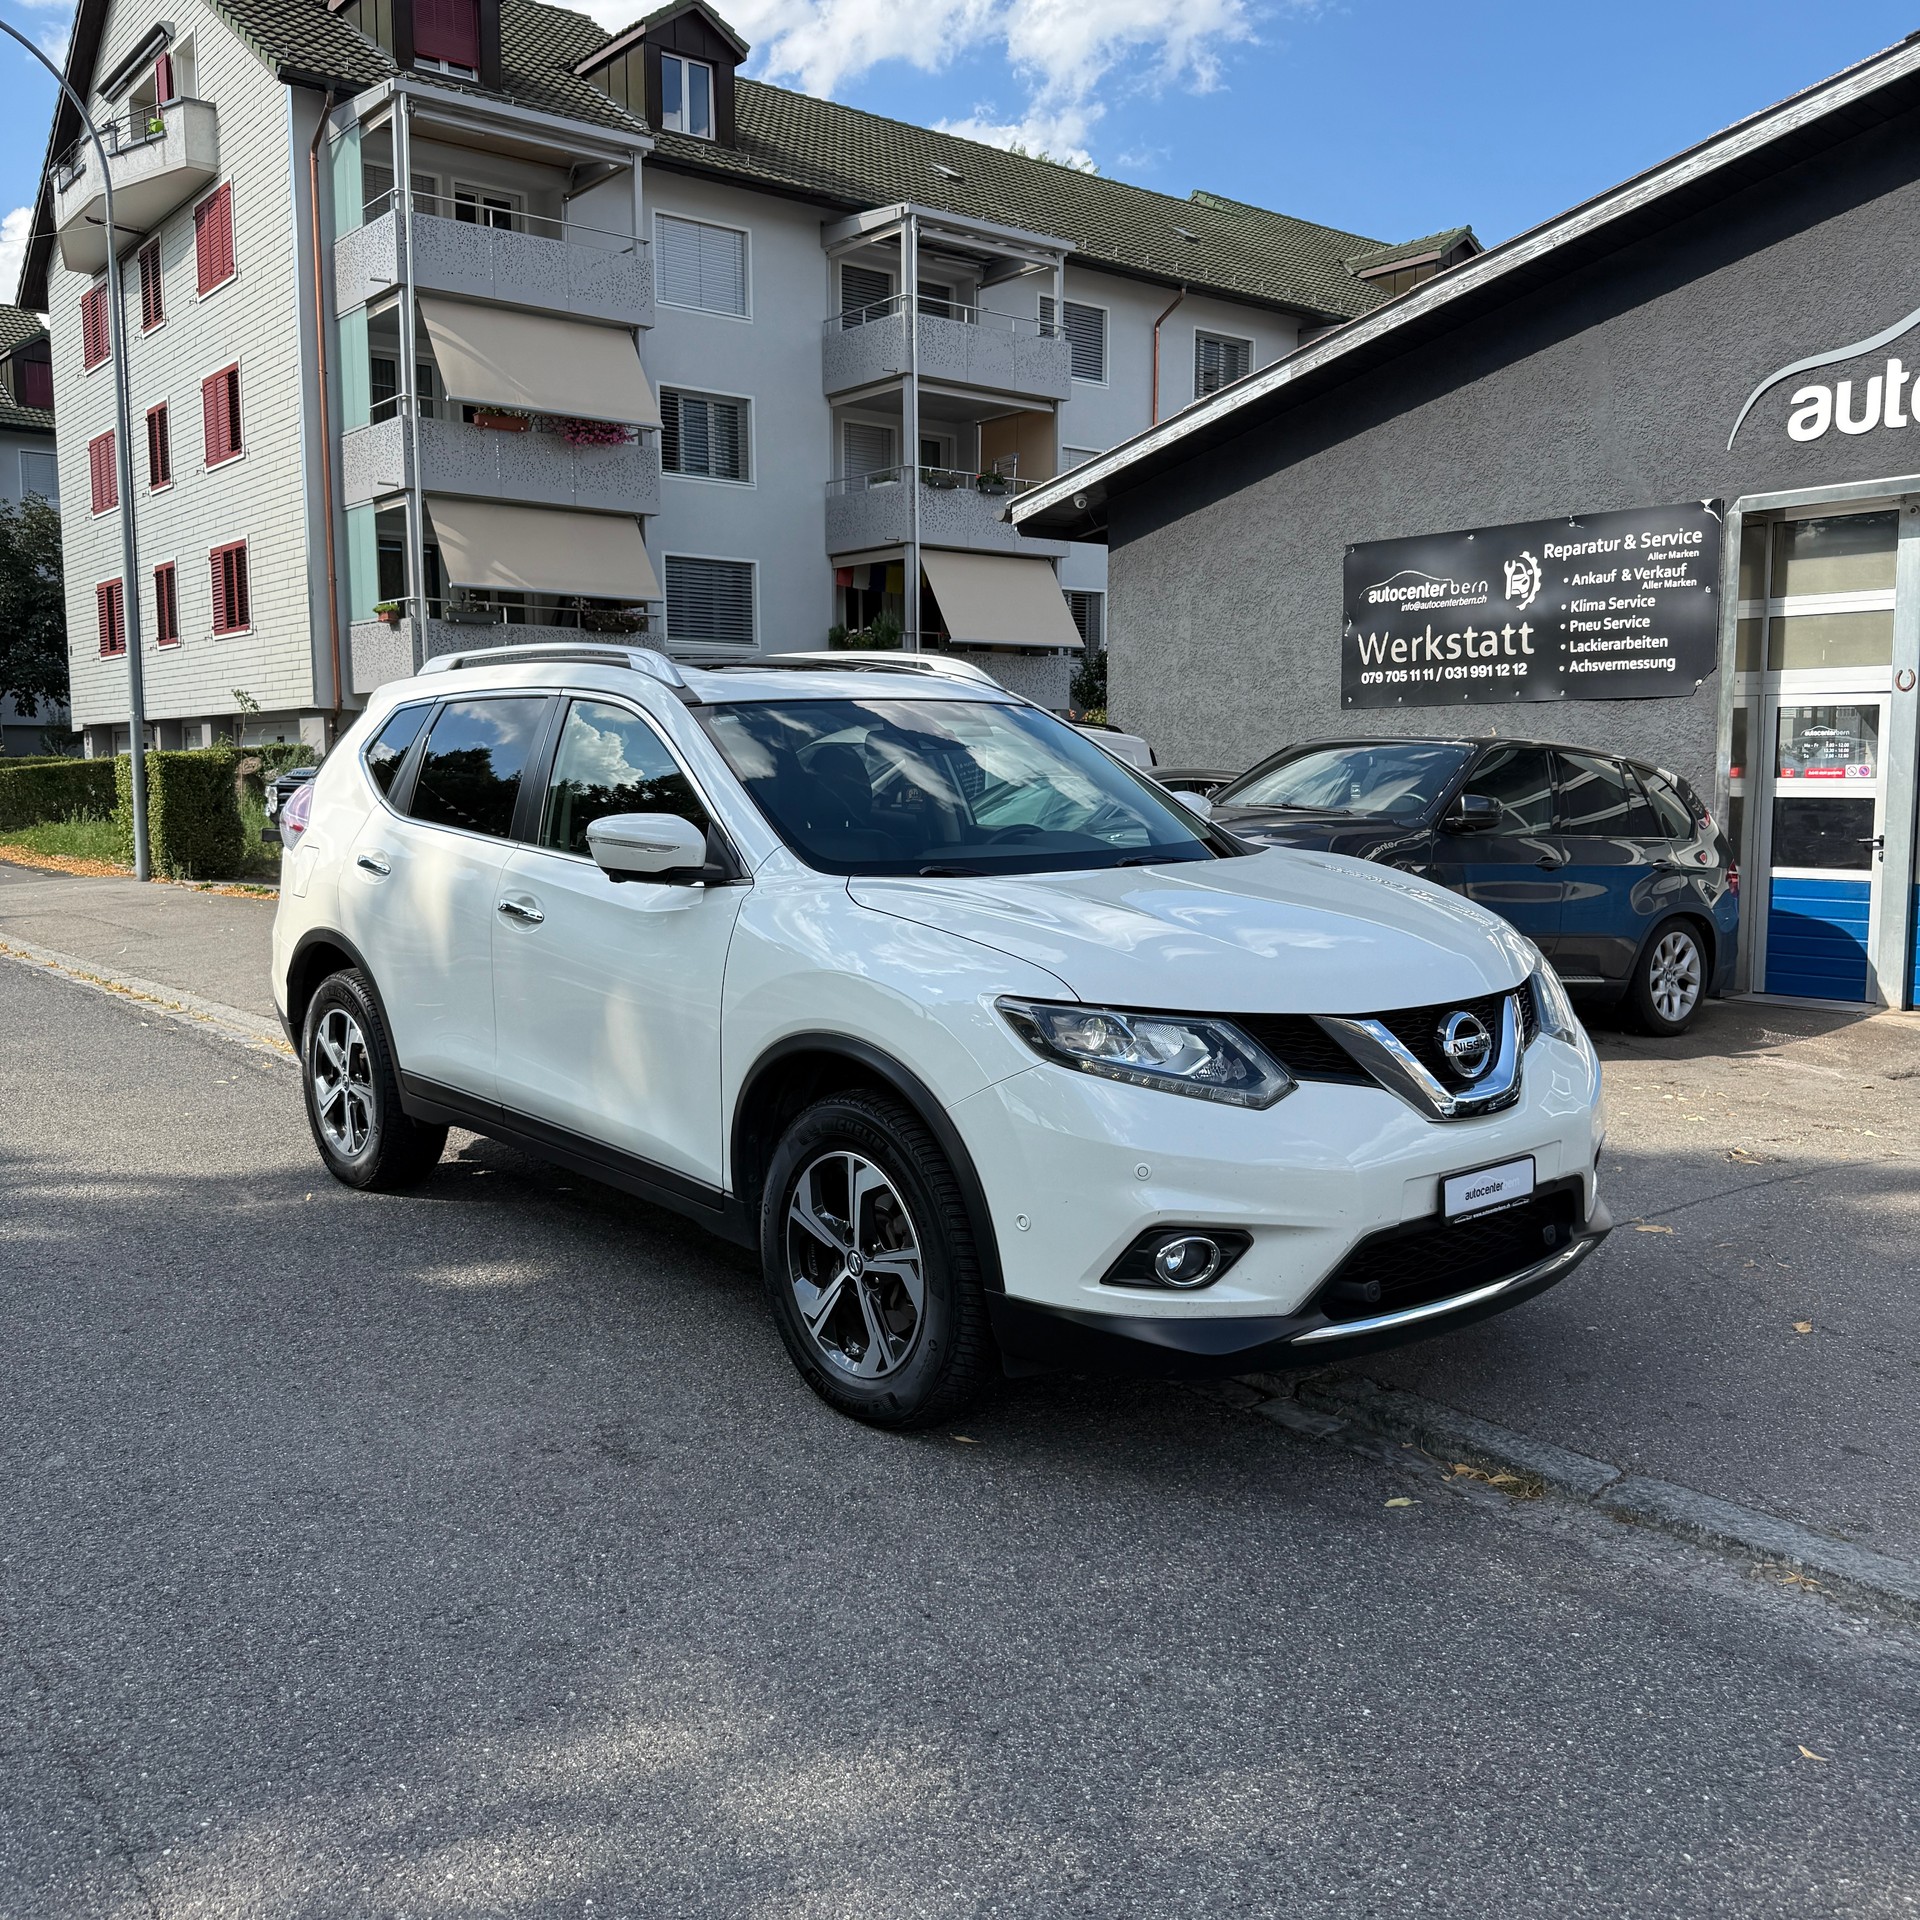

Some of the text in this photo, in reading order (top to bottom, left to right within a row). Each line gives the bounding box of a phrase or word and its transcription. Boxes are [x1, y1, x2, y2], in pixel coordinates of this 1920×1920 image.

[1787, 358, 1920, 442] aut
[1543, 527, 1703, 561] Reparatur & Service
[1647, 549, 1700, 561] Aller Marken
[1571, 563, 1688, 586] Ankauf & Verkauf
[1641, 578, 1698, 590] Aller Marken
[1368, 580, 1489, 604] autocenter bern
[1401, 595, 1488, 612] info@autocenterbern.ch
[1570, 594, 1656, 613] Klima Service
[1569, 615, 1651, 632] Pneu Service
[1357, 621, 1535, 666] Werkstatt
[1569, 635, 1669, 653] Lackierarbeiten
[1361, 662, 1528, 684] 079 705 11 11 / 031 991 12 12
[1569, 658, 1676, 673] Achsvermessung
[1452, 1038, 1490, 1053] NISSAN
[820, 1117, 890, 1151] MICHELIN
[1464, 1181, 1504, 1200] autocenter
